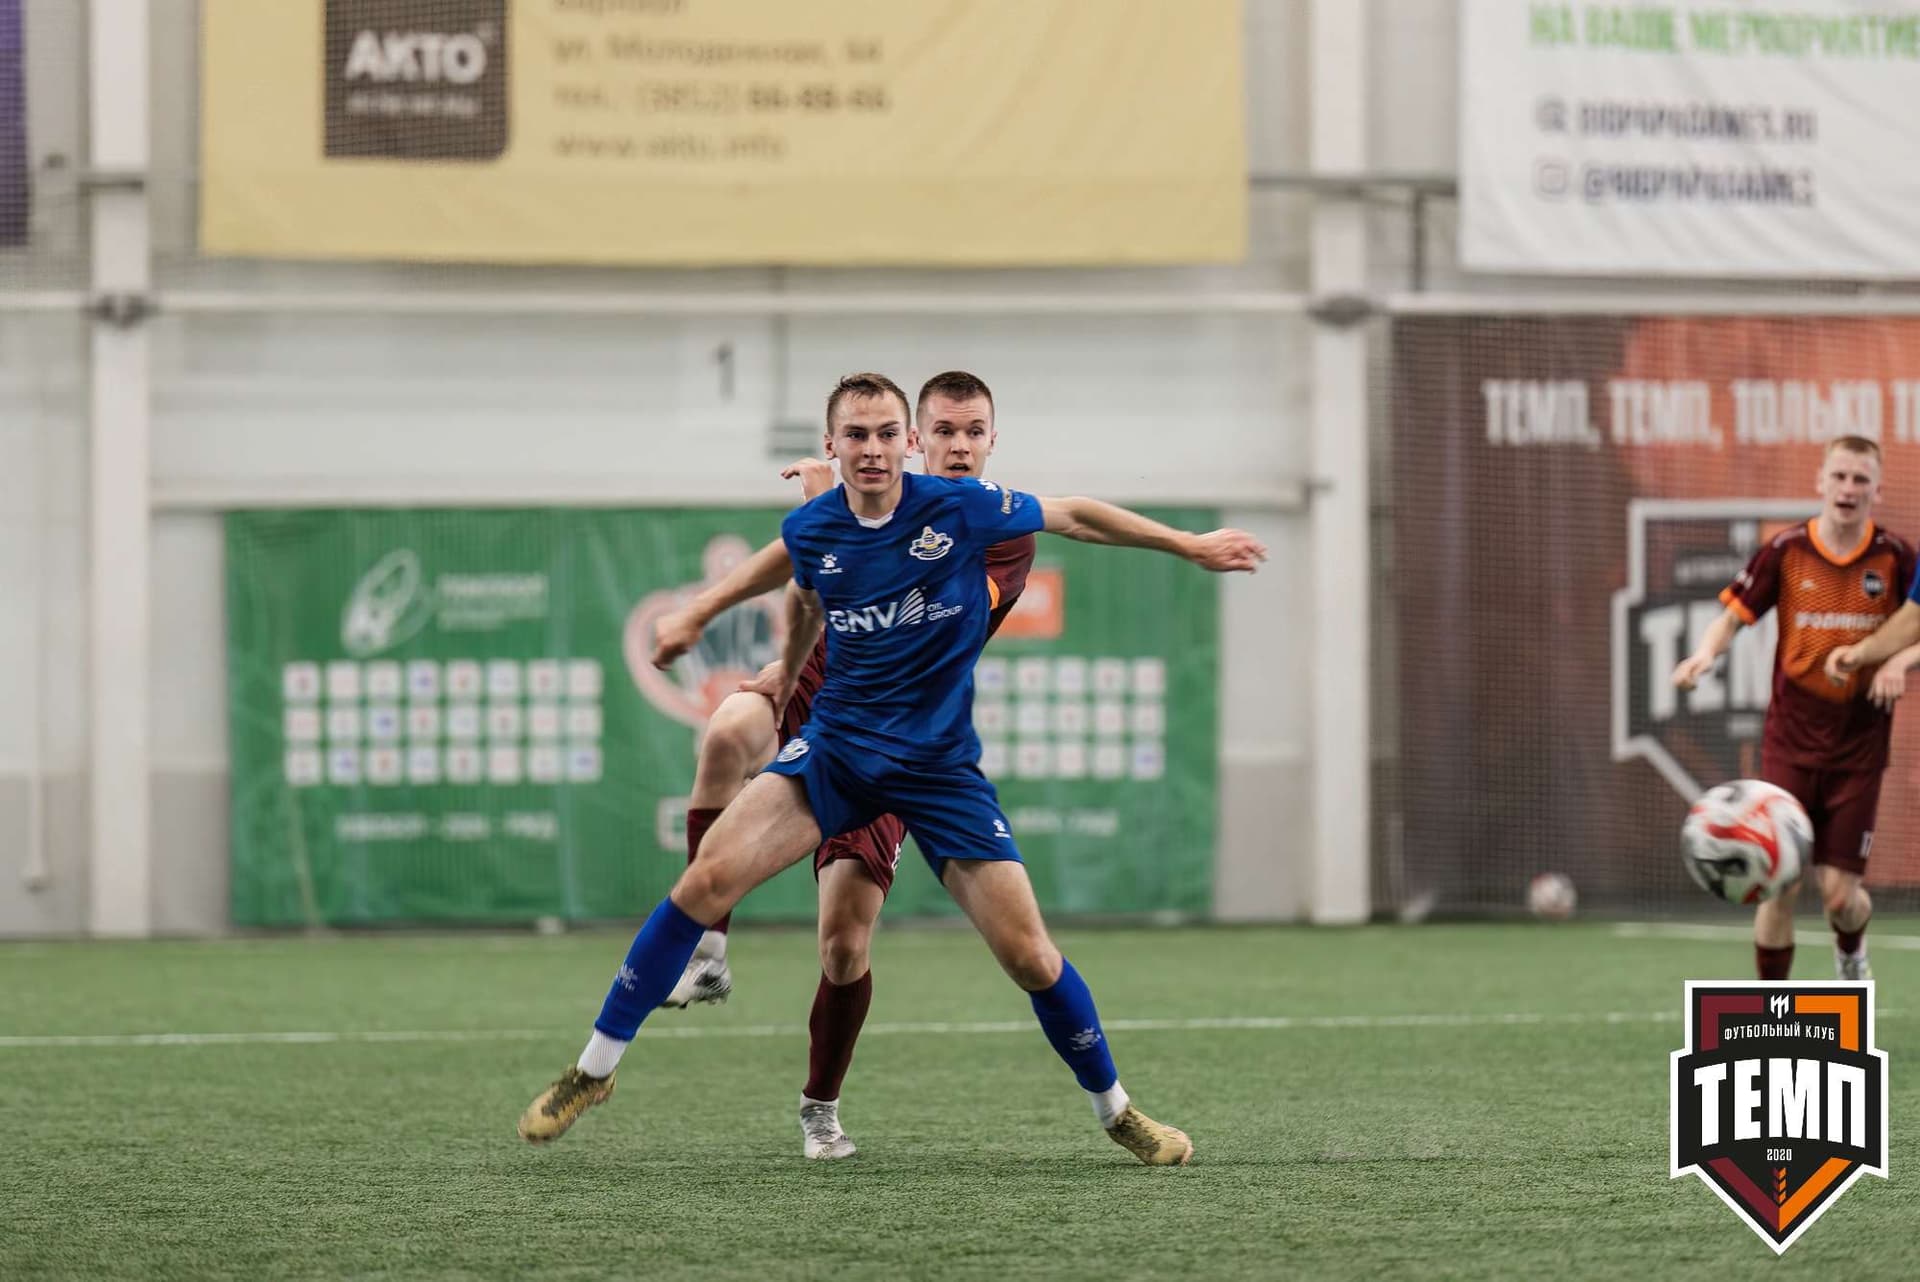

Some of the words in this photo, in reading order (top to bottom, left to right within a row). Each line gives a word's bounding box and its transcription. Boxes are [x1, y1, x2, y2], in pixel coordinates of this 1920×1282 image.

[345, 30, 487, 84] АКТО
[1734, 379, 1884, 446] ТОЛЬКО
[926, 602, 944, 612] OIL
[927, 605, 963, 621] GROUP
[1641, 600, 1779, 721] ТЕМ
